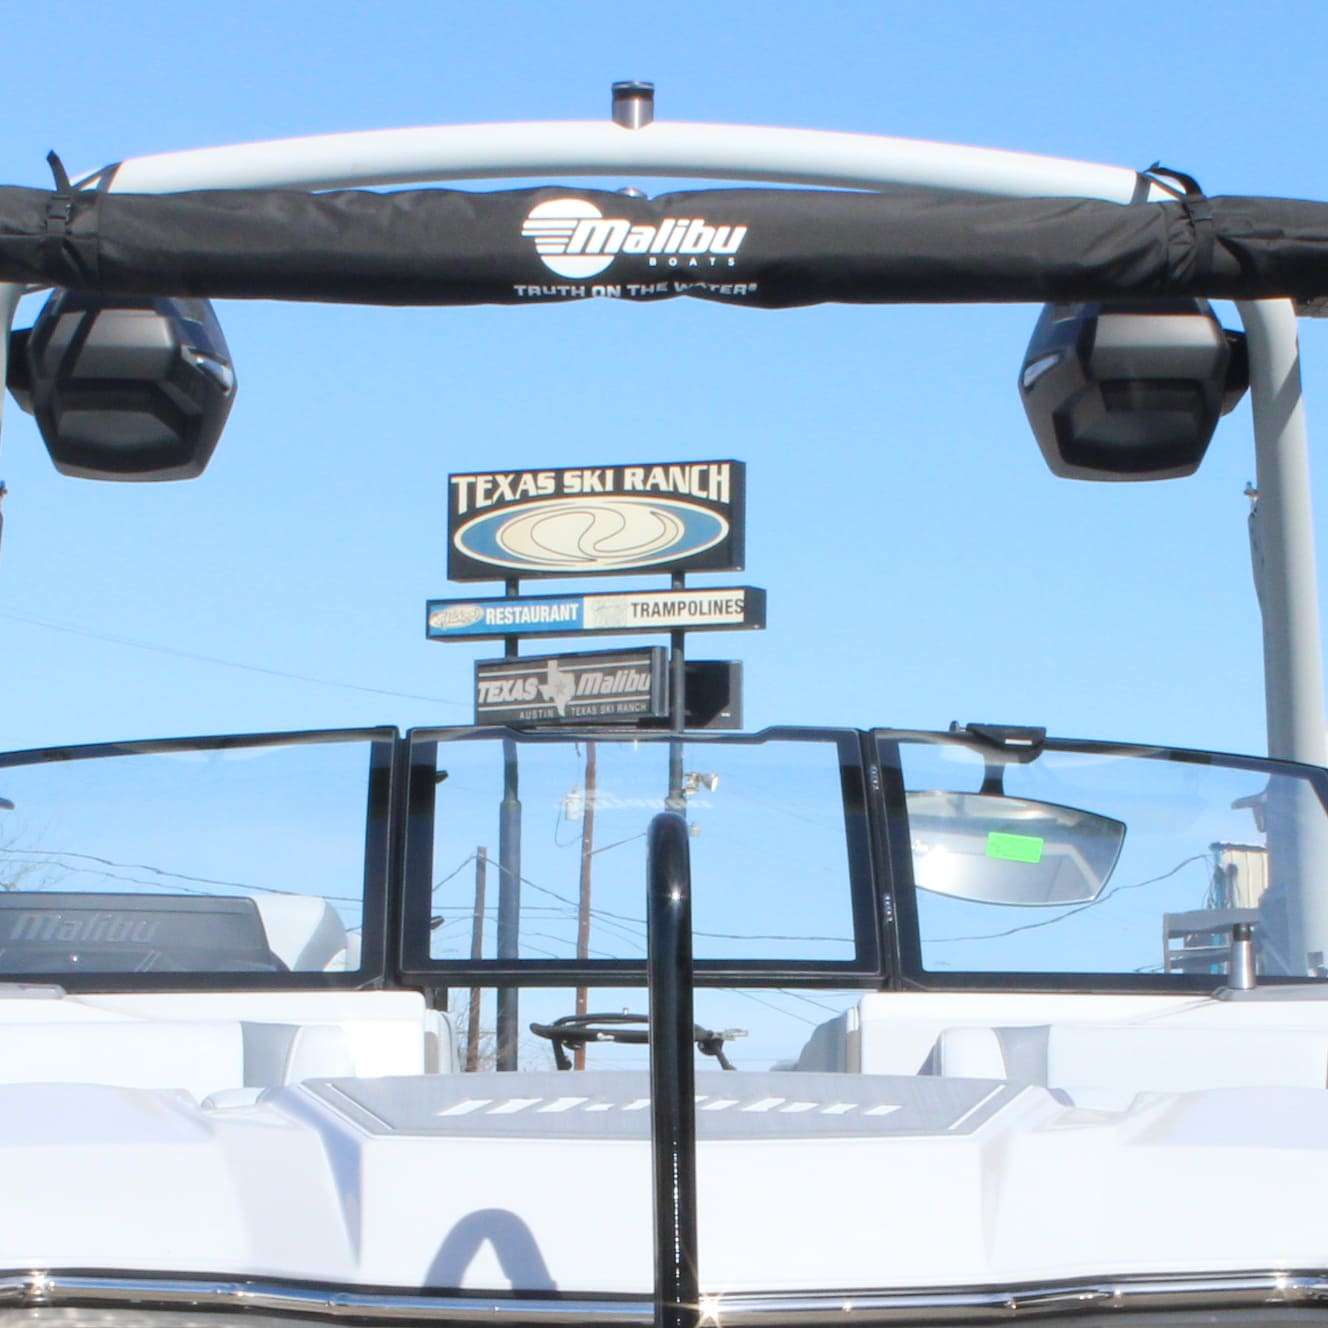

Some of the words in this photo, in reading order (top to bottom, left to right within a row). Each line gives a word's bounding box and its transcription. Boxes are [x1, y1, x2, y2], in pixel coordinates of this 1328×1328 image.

[566, 218, 748, 254] Malibu
[648, 256, 736, 267] BOATS
[513, 284, 586, 297] TRUTH
[591, 284, 621, 298] ON
[626, 281, 669, 295] THE
[450, 471, 556, 516] TEXAS
[562, 467, 615, 494] SKI
[624, 463, 731, 504] RANCH
[485, 603, 580, 626] RESTAURANT
[630, 598, 746, 618] TRAMPOLINES
[478, 676, 540, 704] TEXAS
[576, 667, 650, 697] Malibu
[519, 708, 555, 720] AUSTIN
[570, 705, 598, 718] TEXAS
[600, 704, 616, 715] SKI
[617, 703, 647, 714] RANCH
[7, 911, 161, 944] Malibu
